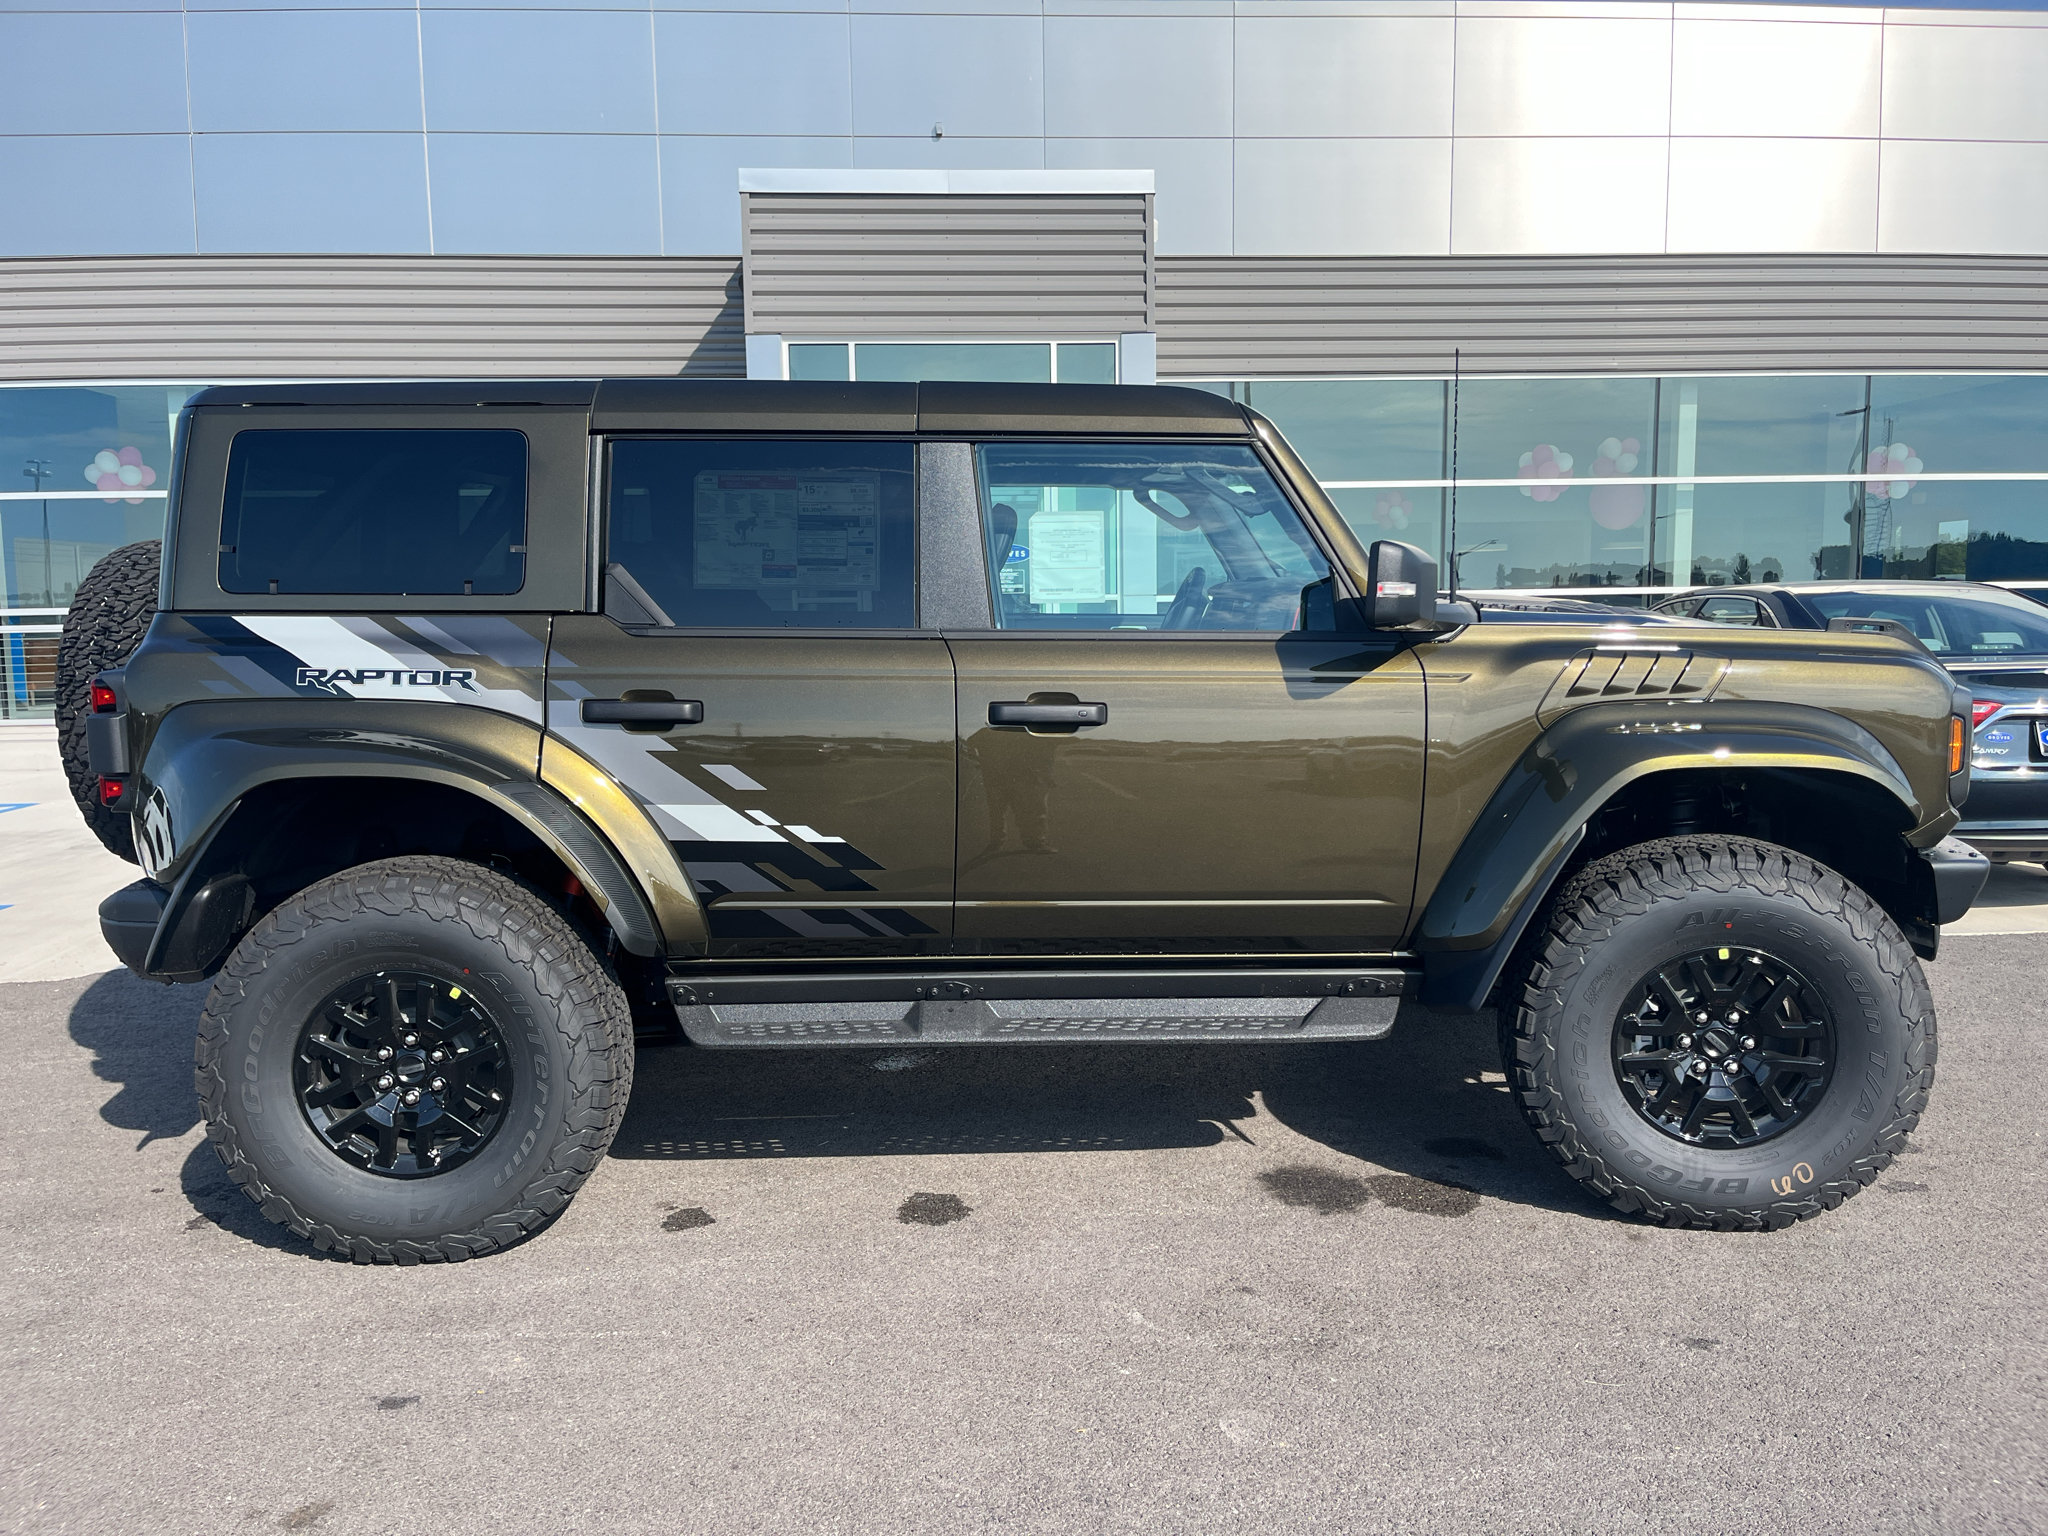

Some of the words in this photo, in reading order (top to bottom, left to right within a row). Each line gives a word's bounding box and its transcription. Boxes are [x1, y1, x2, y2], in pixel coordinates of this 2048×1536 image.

[296, 667, 482, 697] RAPTOR
[240, 937, 358, 1171] BFGoodrich
[1569, 1010, 1750, 1196] BFGoodrich
